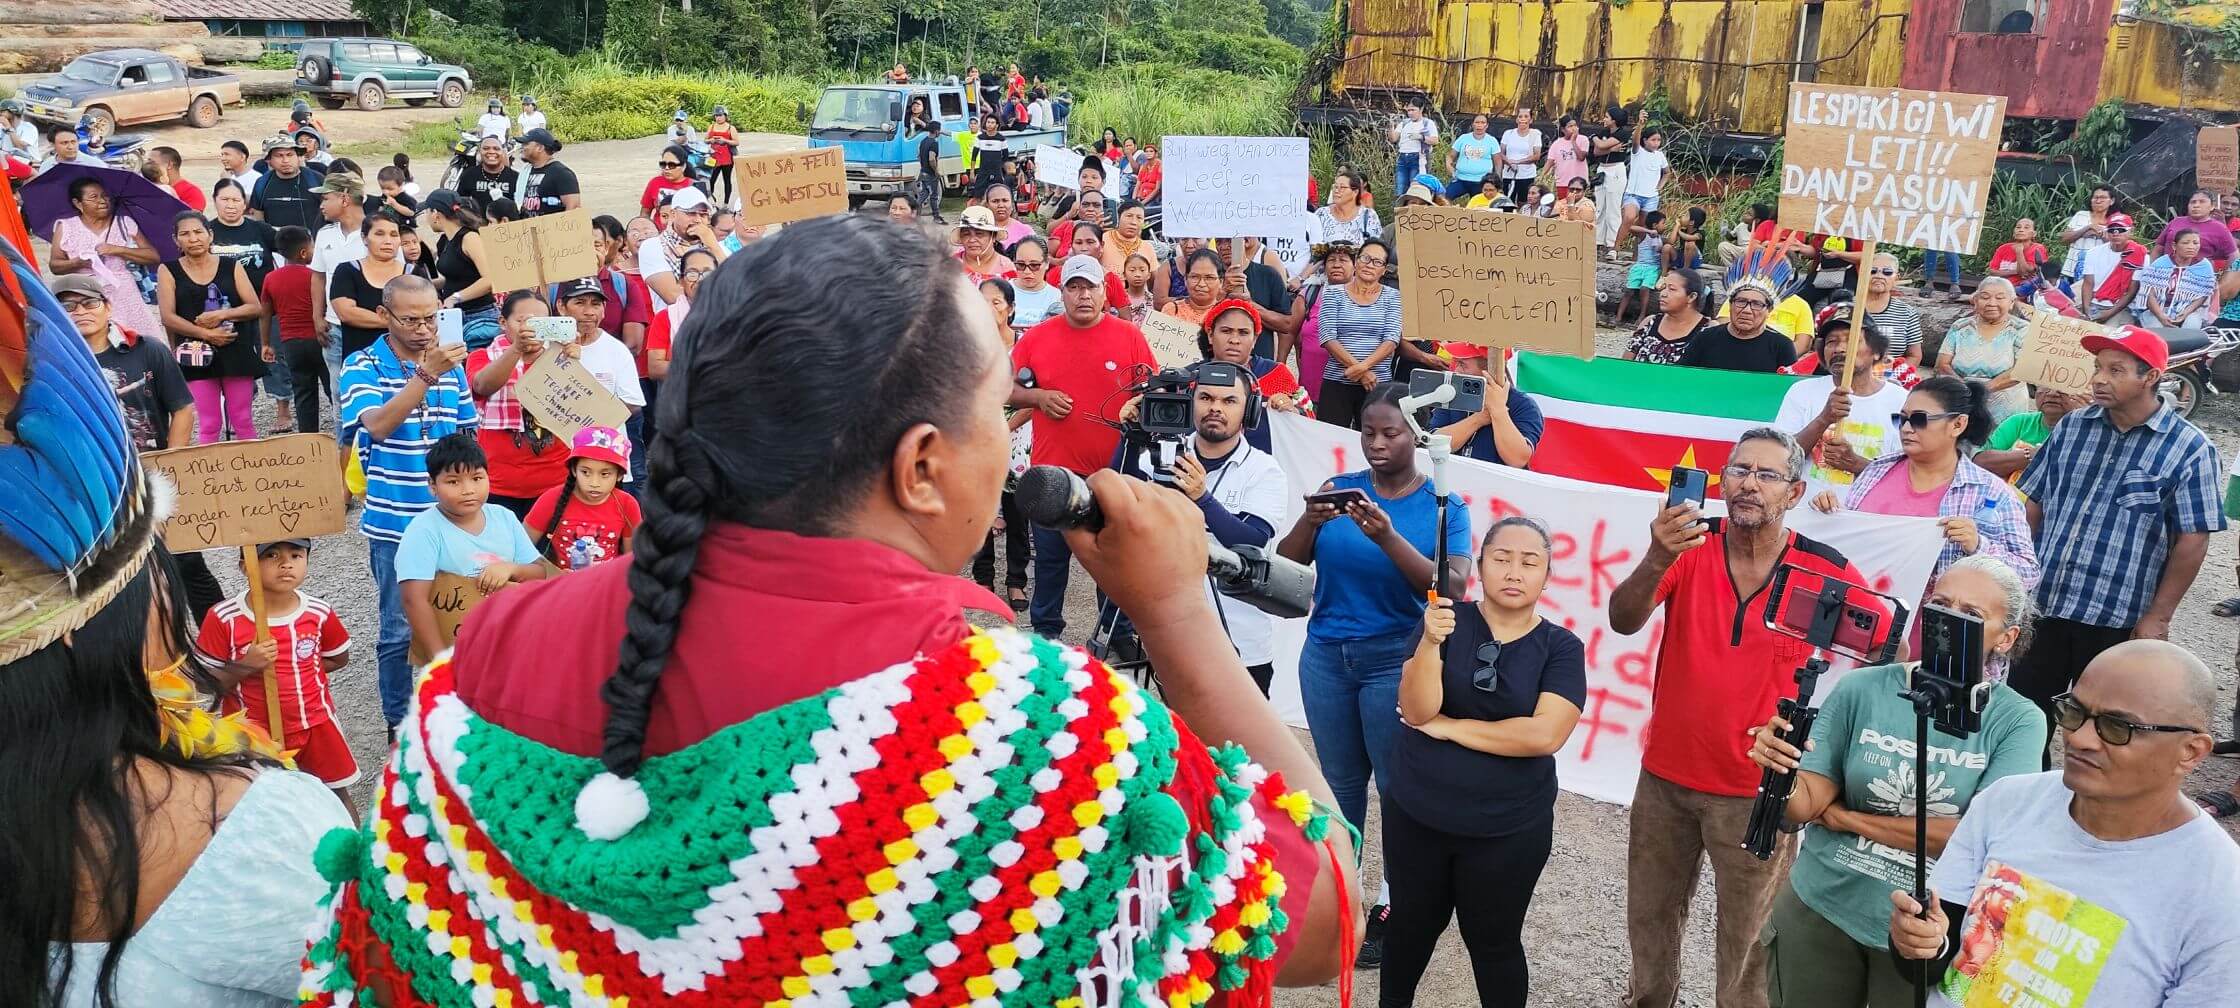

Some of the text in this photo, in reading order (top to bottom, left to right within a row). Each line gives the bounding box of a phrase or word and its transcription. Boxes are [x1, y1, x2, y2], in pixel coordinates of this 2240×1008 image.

[1241, 173, 1260, 186] en
[1525, 219, 1560, 237] de
[1515, 267, 1555, 287] hun
[1859, 728, 1986, 769] POSTIVE
